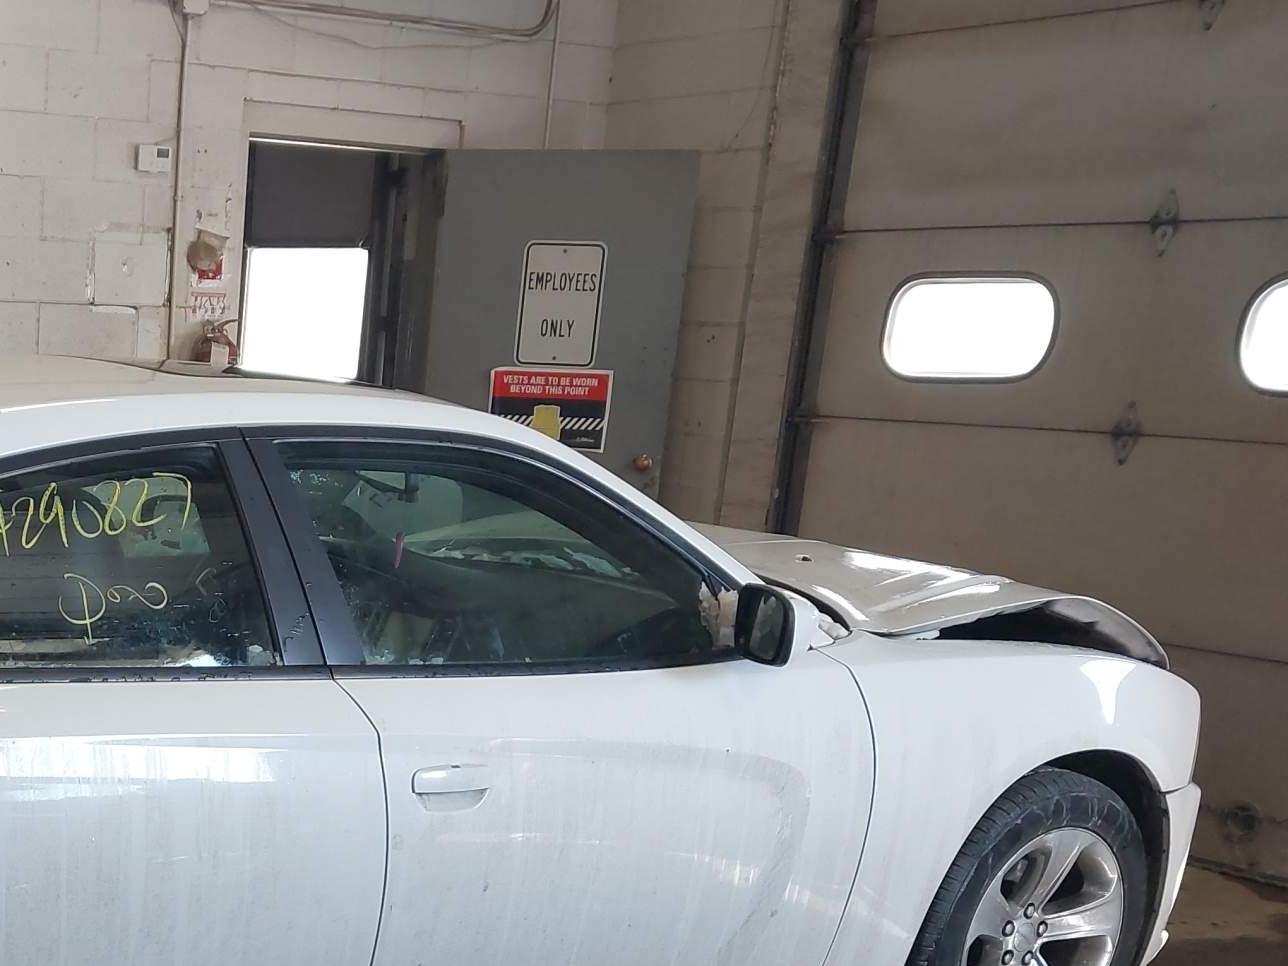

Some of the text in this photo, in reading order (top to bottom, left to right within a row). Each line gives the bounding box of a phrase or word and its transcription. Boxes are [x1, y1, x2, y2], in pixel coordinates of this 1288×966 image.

[528, 272, 597, 291] EMPLOYEES
[540, 319, 575, 337] ONLY
[503, 375, 598, 386] VESTS ARE TO BE WORN
[510, 385, 590, 395] BEYOND THIS POINT
